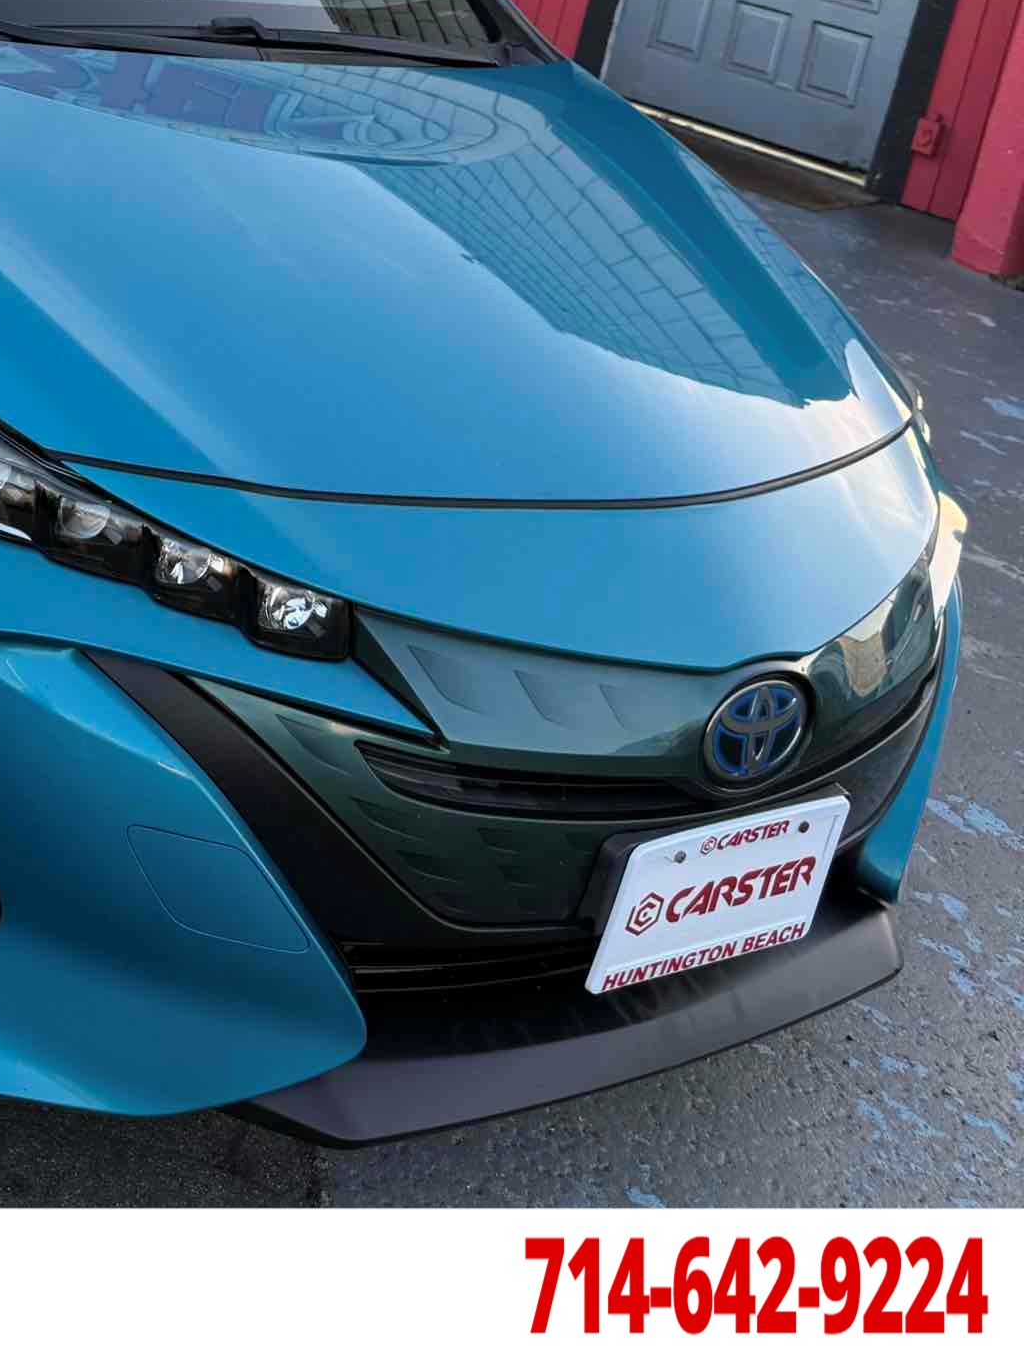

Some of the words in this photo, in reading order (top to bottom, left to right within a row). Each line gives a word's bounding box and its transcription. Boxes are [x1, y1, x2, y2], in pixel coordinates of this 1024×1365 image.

[716, 819, 790, 851] CARSTER
[666, 855, 817, 923] CARSTER
[601, 941, 738, 991] HUNTINGTON
[743, 921, 807, 952] BEACH
